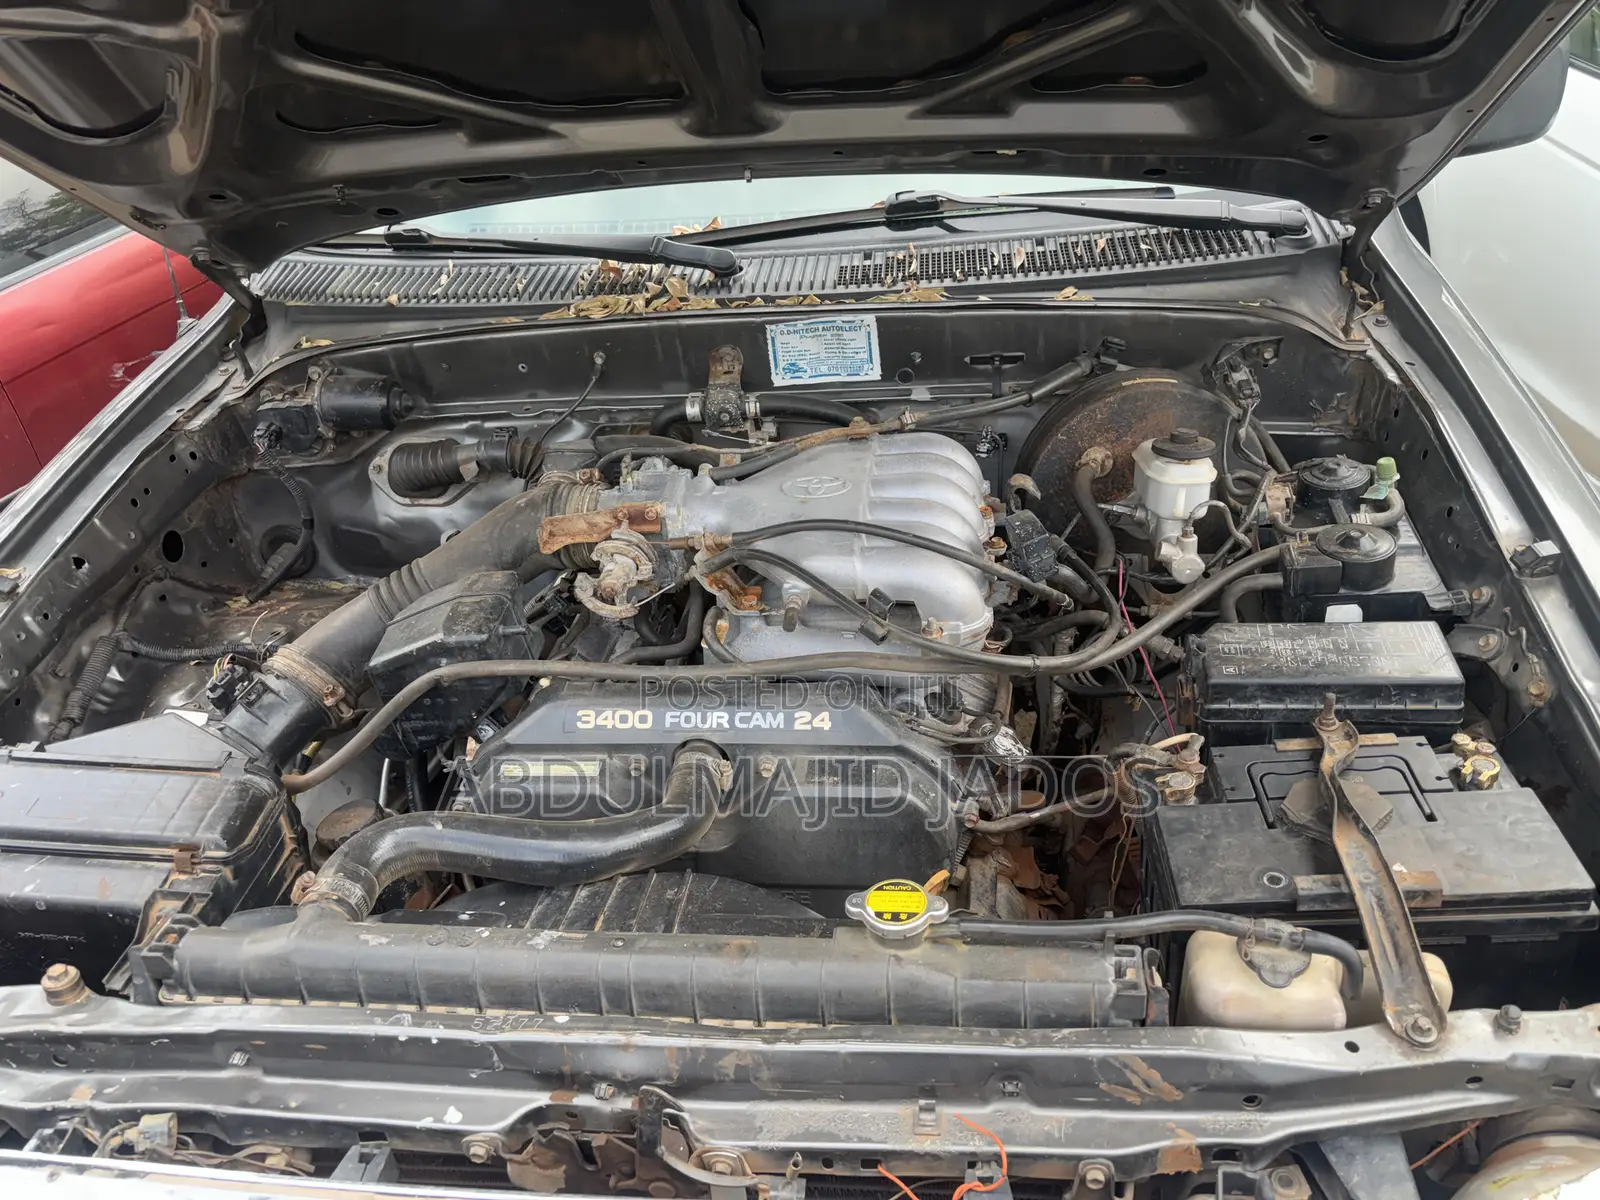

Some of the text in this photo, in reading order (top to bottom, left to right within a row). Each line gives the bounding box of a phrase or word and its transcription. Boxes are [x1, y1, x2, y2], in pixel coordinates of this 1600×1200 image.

[576, 709, 832, 730] 3400 FOUR CAM 24
